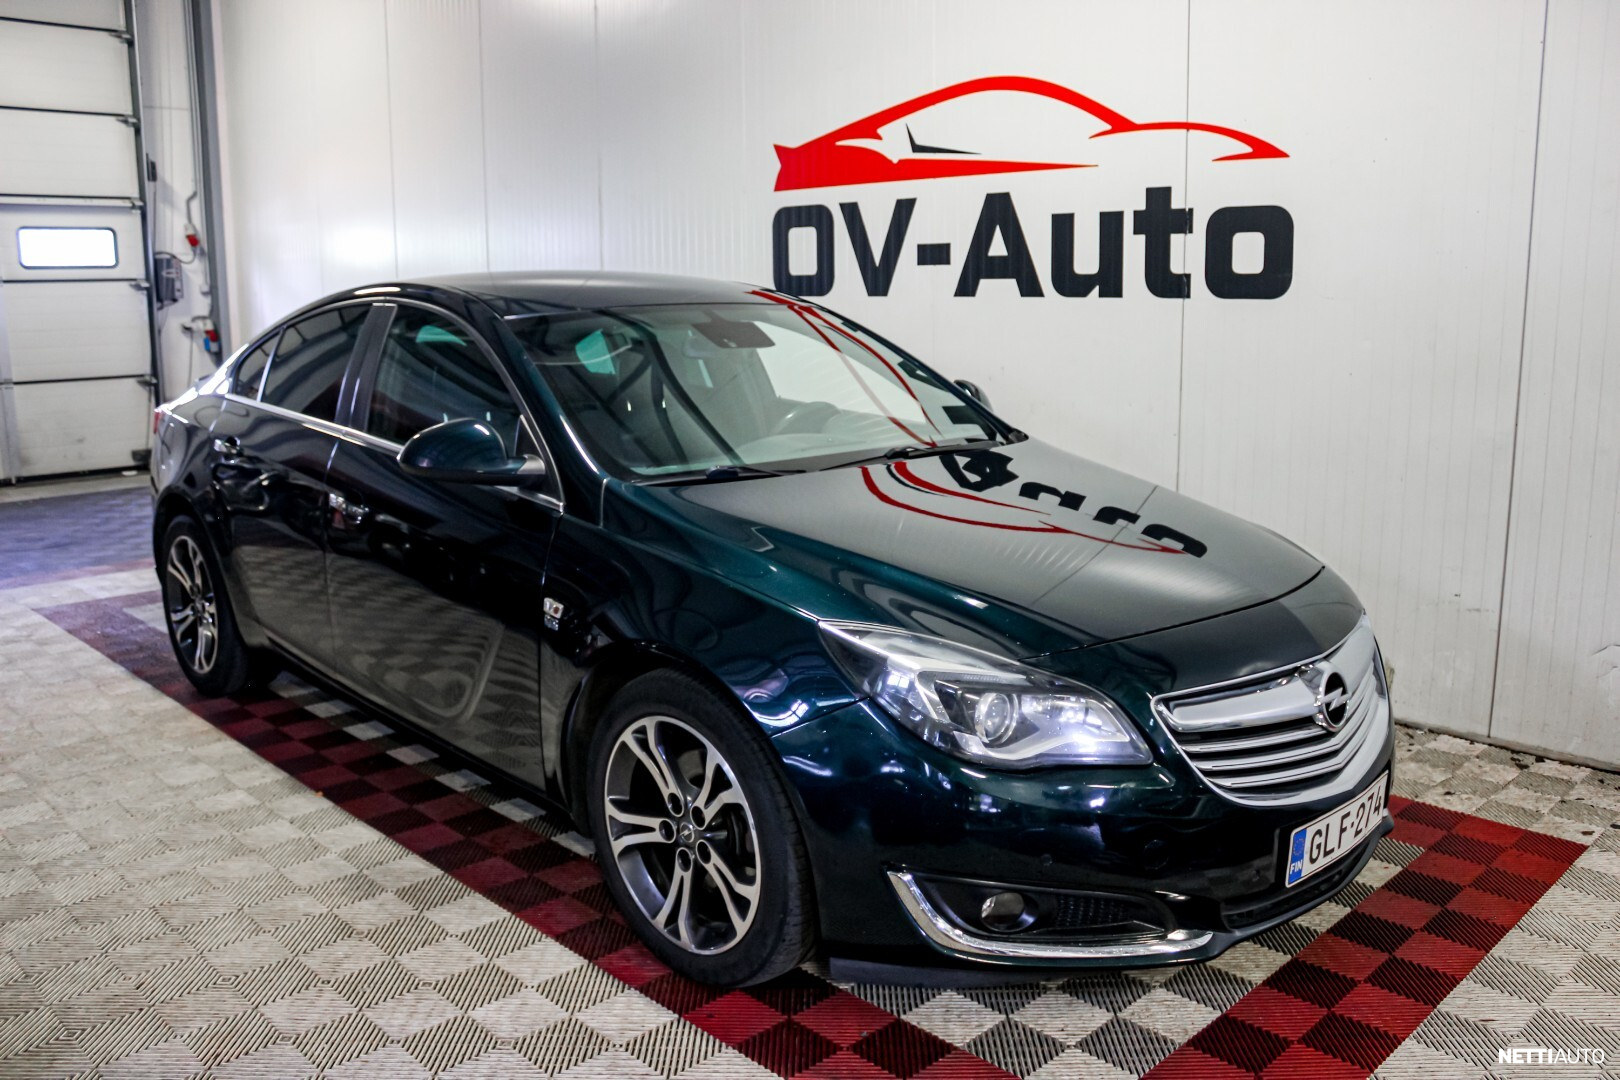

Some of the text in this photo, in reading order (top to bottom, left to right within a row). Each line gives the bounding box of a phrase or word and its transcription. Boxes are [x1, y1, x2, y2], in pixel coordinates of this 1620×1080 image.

[772, 186, 1294, 299] OV-Auto
[1309, 786, 1382, 865] GLF-274
[1290, 860, 1303, 875] FIN
